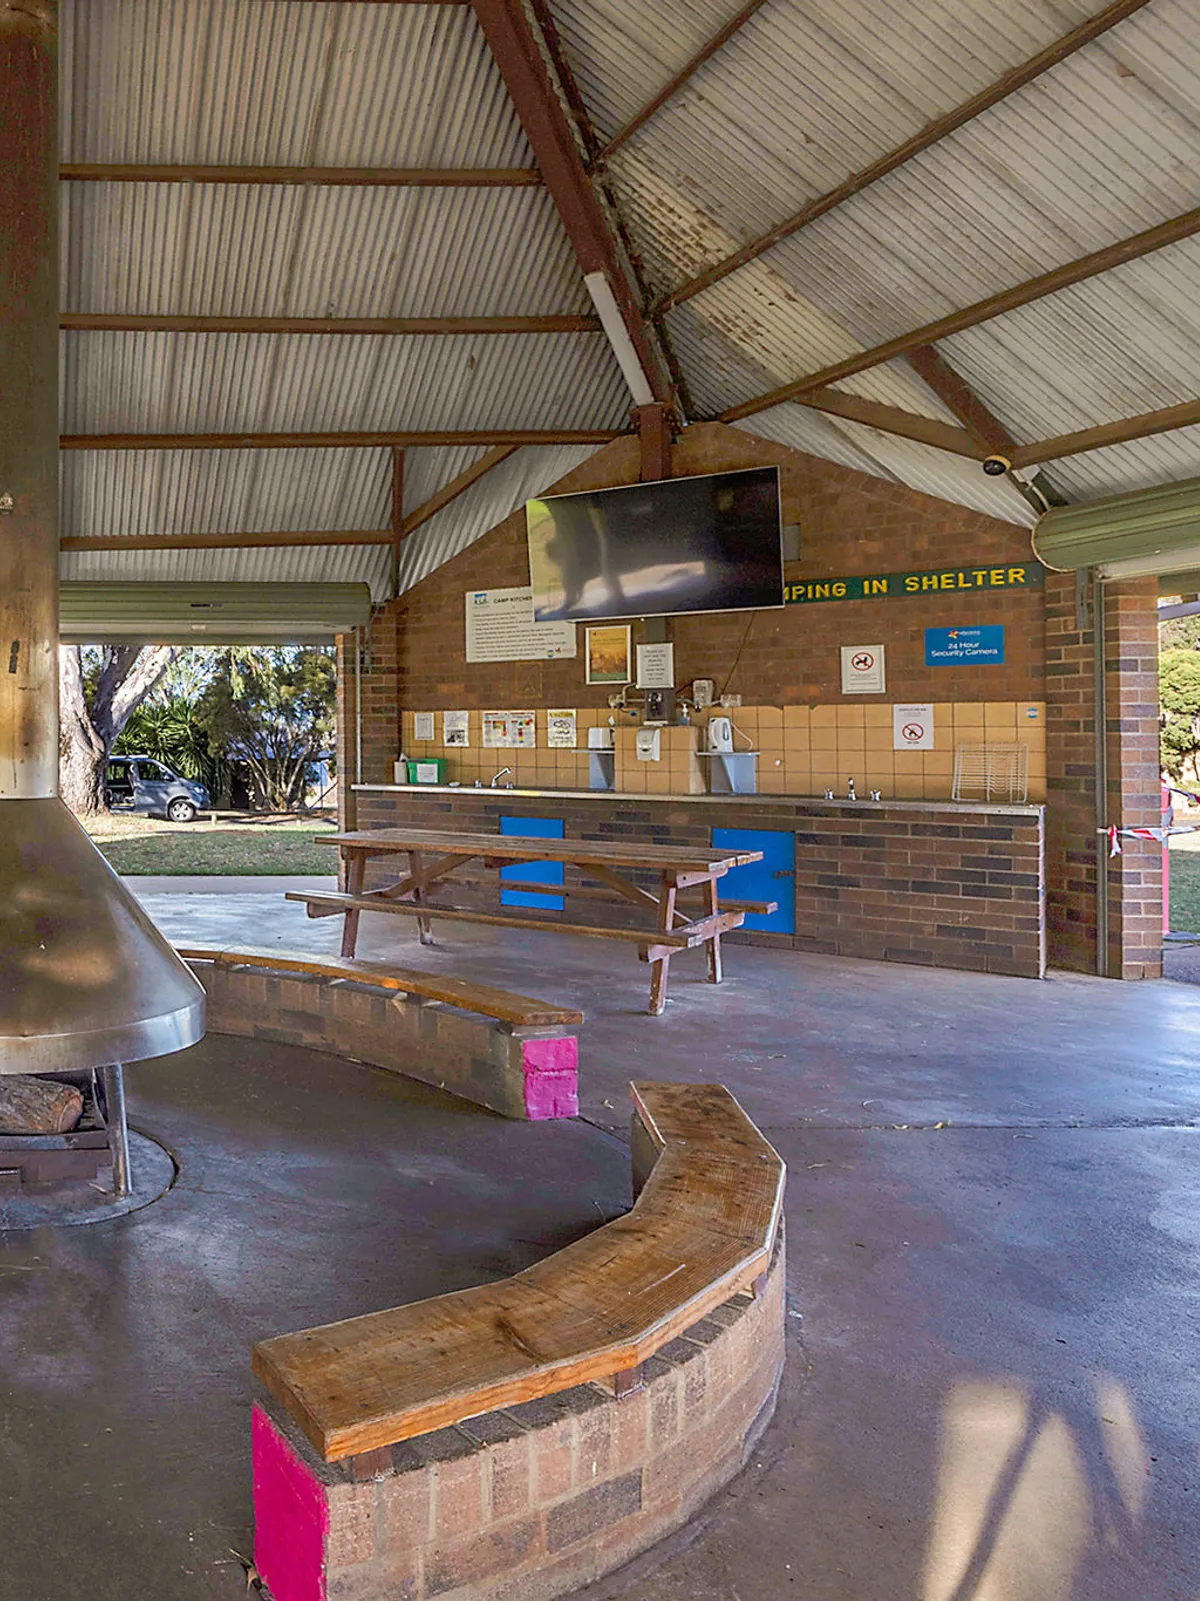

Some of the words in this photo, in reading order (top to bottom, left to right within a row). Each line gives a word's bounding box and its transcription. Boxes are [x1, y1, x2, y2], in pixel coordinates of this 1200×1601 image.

[863, 579, 888, 595] IN
[905, 568, 1026, 592] SHELTER
[931, 649, 964, 657] Security
[965, 648, 998, 656] Camera
